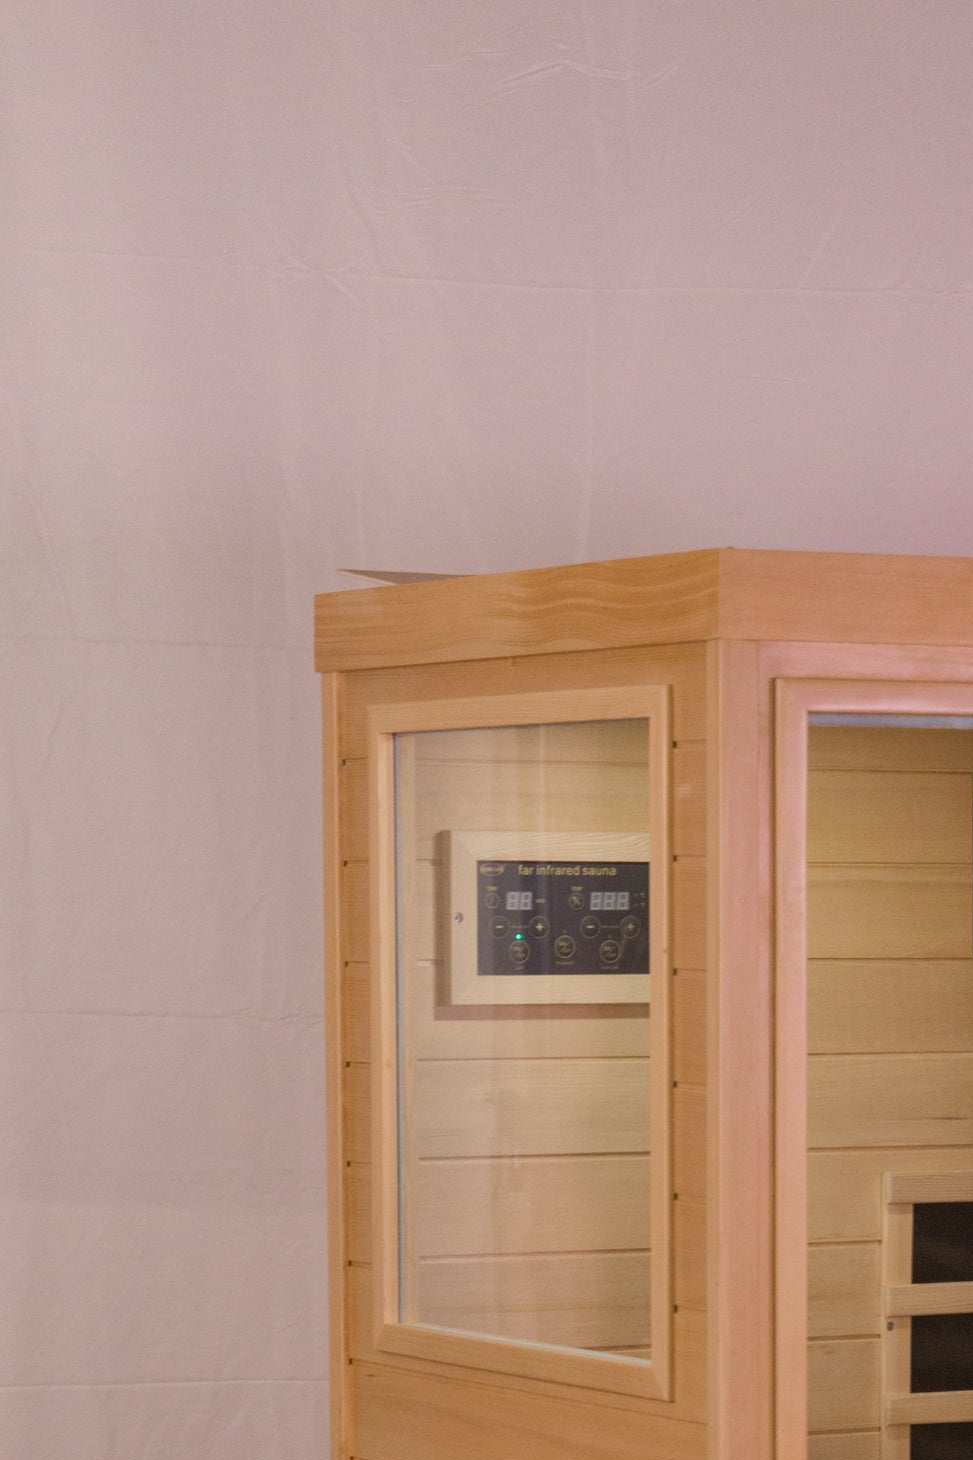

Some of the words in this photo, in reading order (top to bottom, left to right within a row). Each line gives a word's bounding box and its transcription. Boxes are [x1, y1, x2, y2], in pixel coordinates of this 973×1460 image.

[518, 864, 534, 876] far
[536, 864, 580, 876] infrared
[582, 866, 617, 876] sauna
